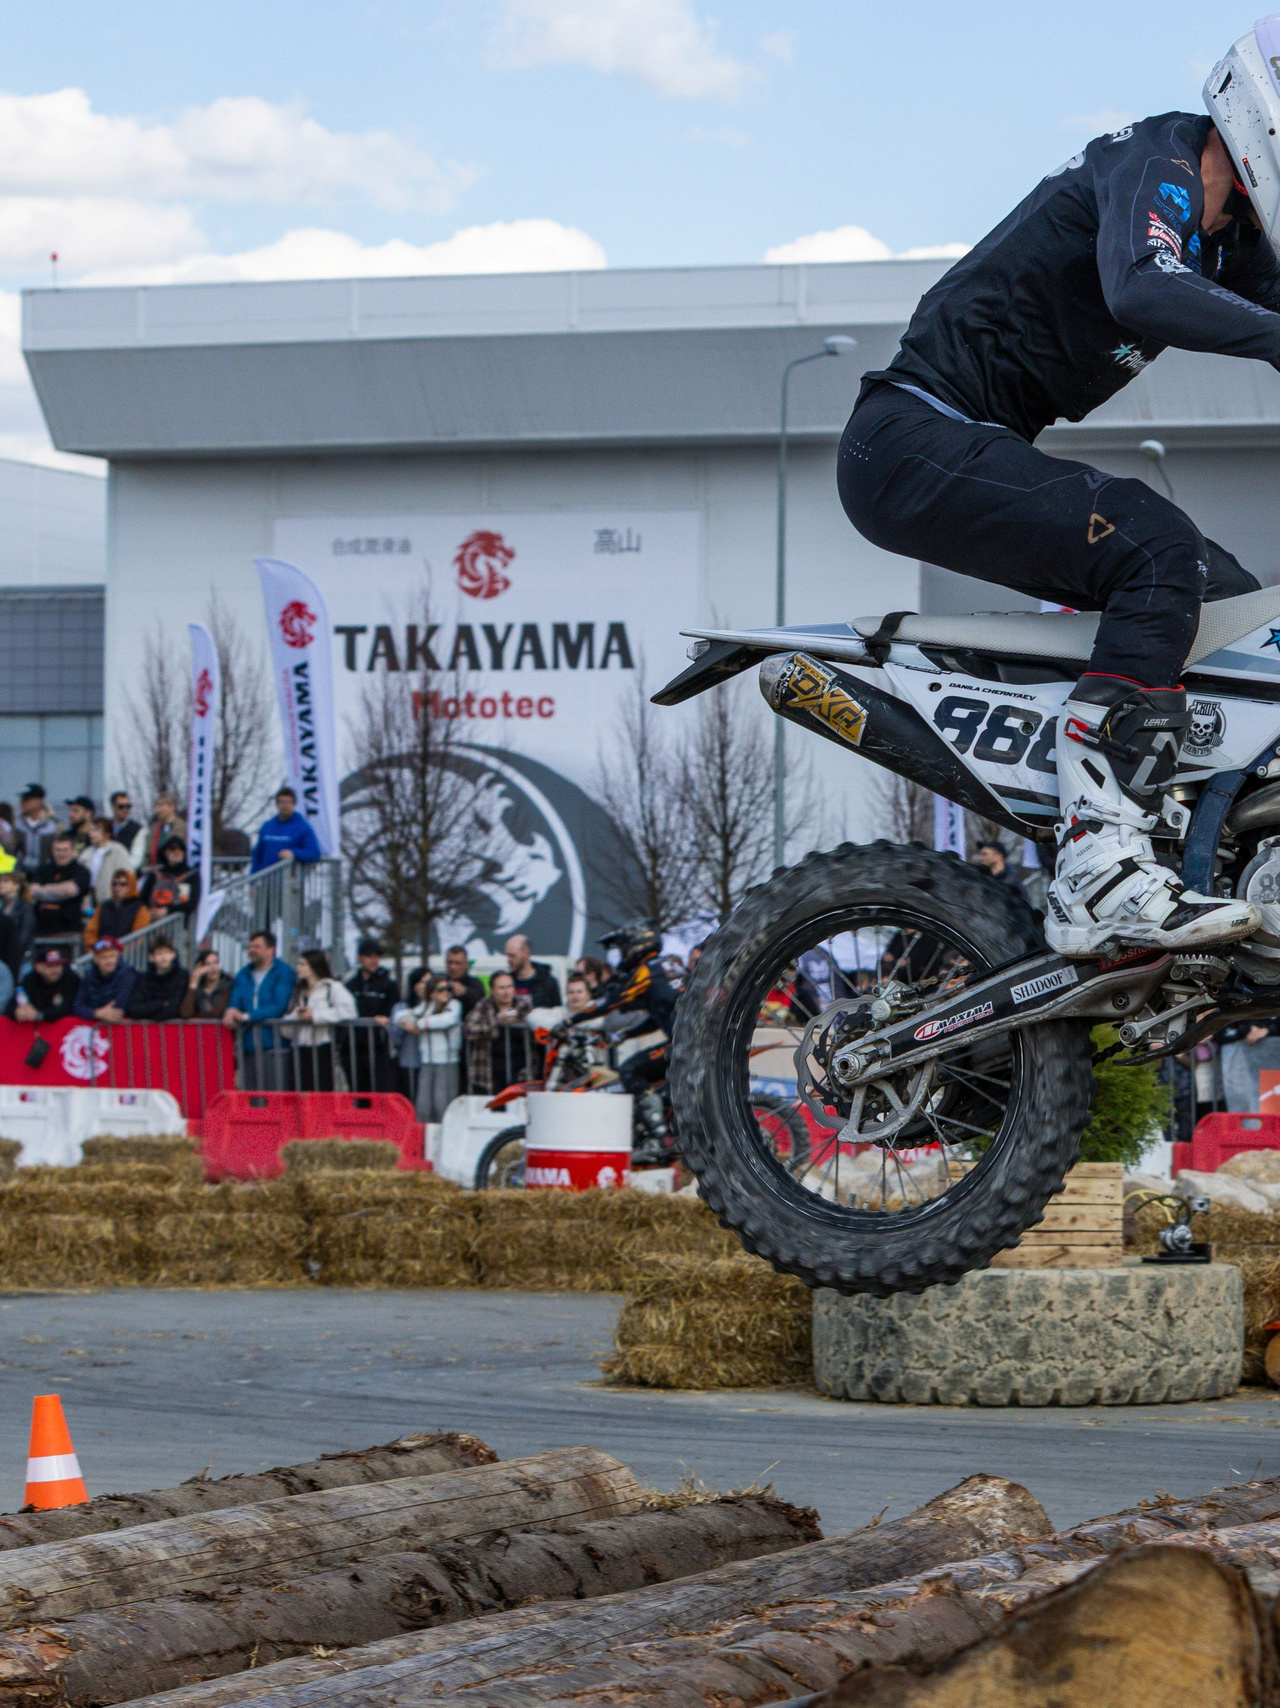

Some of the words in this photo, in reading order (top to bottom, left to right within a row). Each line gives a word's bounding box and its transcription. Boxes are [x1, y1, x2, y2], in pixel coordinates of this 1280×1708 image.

[334, 621, 635, 672] TAKAYAMA
[411, 690, 556, 720] Mototec
[949, 682, 981, 692] DANILA
[982, 687, 1037, 702] CHERNYAEV
[1143, 718, 1170, 727] LEATT
[293, 661, 319, 817] TAKAYAMA
[1048, 890, 1073, 925] LEATT
[1013, 974, 1064, 1001] SHADOOF
